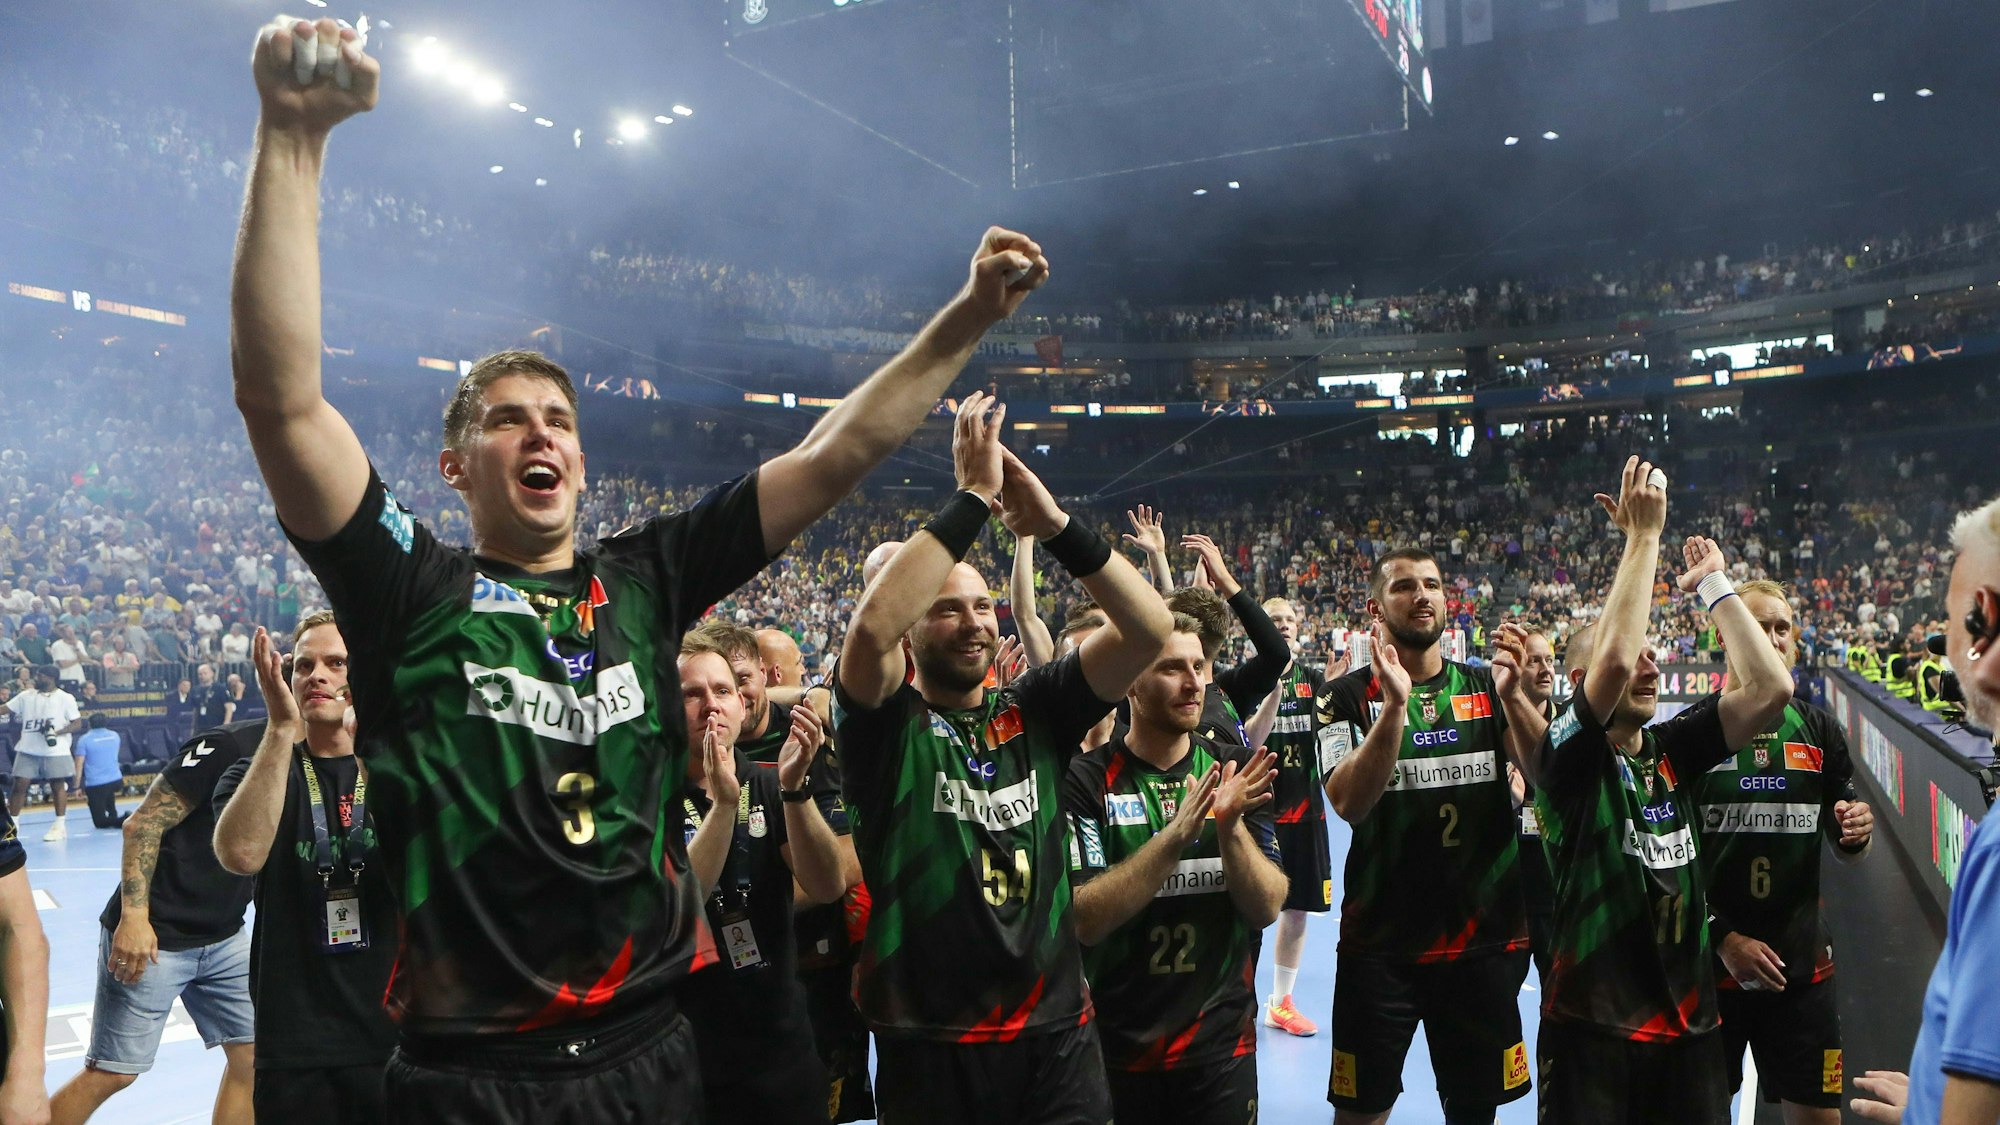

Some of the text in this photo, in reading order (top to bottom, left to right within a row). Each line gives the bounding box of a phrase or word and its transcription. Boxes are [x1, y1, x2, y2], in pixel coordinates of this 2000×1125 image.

[72, 290, 91, 312] VS
[473, 578, 526, 601] DK
[1326, 726, 1349, 734] Zerbst
[1413, 729, 1458, 746] GETEC
[1284, 745, 1301, 768] 23
[1792, 750, 1806, 758] eab
[1404, 762, 1491, 785] Humanas
[1740, 777, 1786, 790] GETEC
[557, 773, 595, 845] 3
[1107, 800, 1145, 818] DKB
[1727, 810, 1812, 828] Humanas
[1439, 803, 1460, 848] 2
[982, 849, 1031, 906] 54
[1161, 870, 1225, 889] mana
[1750, 856, 1772, 899] 6
[1150, 923, 1197, 974] 22
